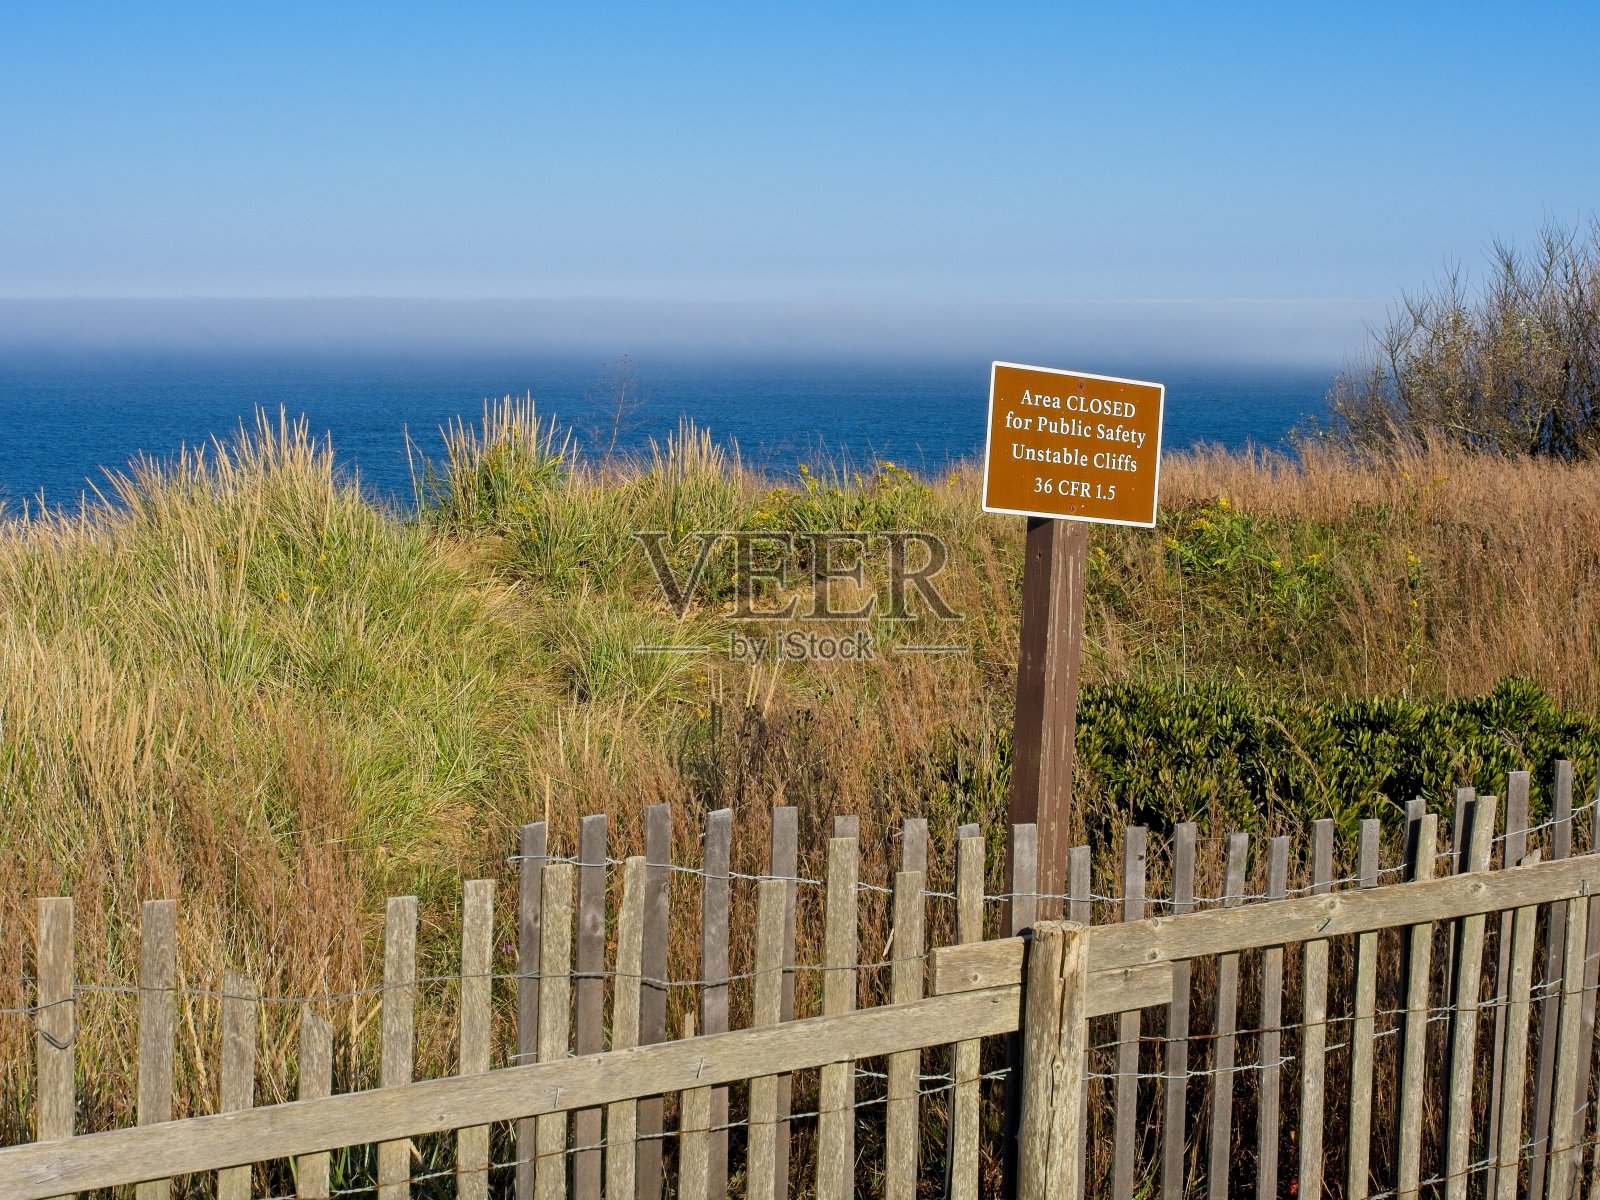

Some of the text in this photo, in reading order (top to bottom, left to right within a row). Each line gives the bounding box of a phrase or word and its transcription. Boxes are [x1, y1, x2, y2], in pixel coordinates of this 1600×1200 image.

[1021, 389, 1136, 418] Area CLOSED
[1005, 411, 1146, 448] for Public Safety
[1012, 443, 1137, 472] Unstable Cliffs
[1033, 477, 1116, 500] 36 CFR 1.5
